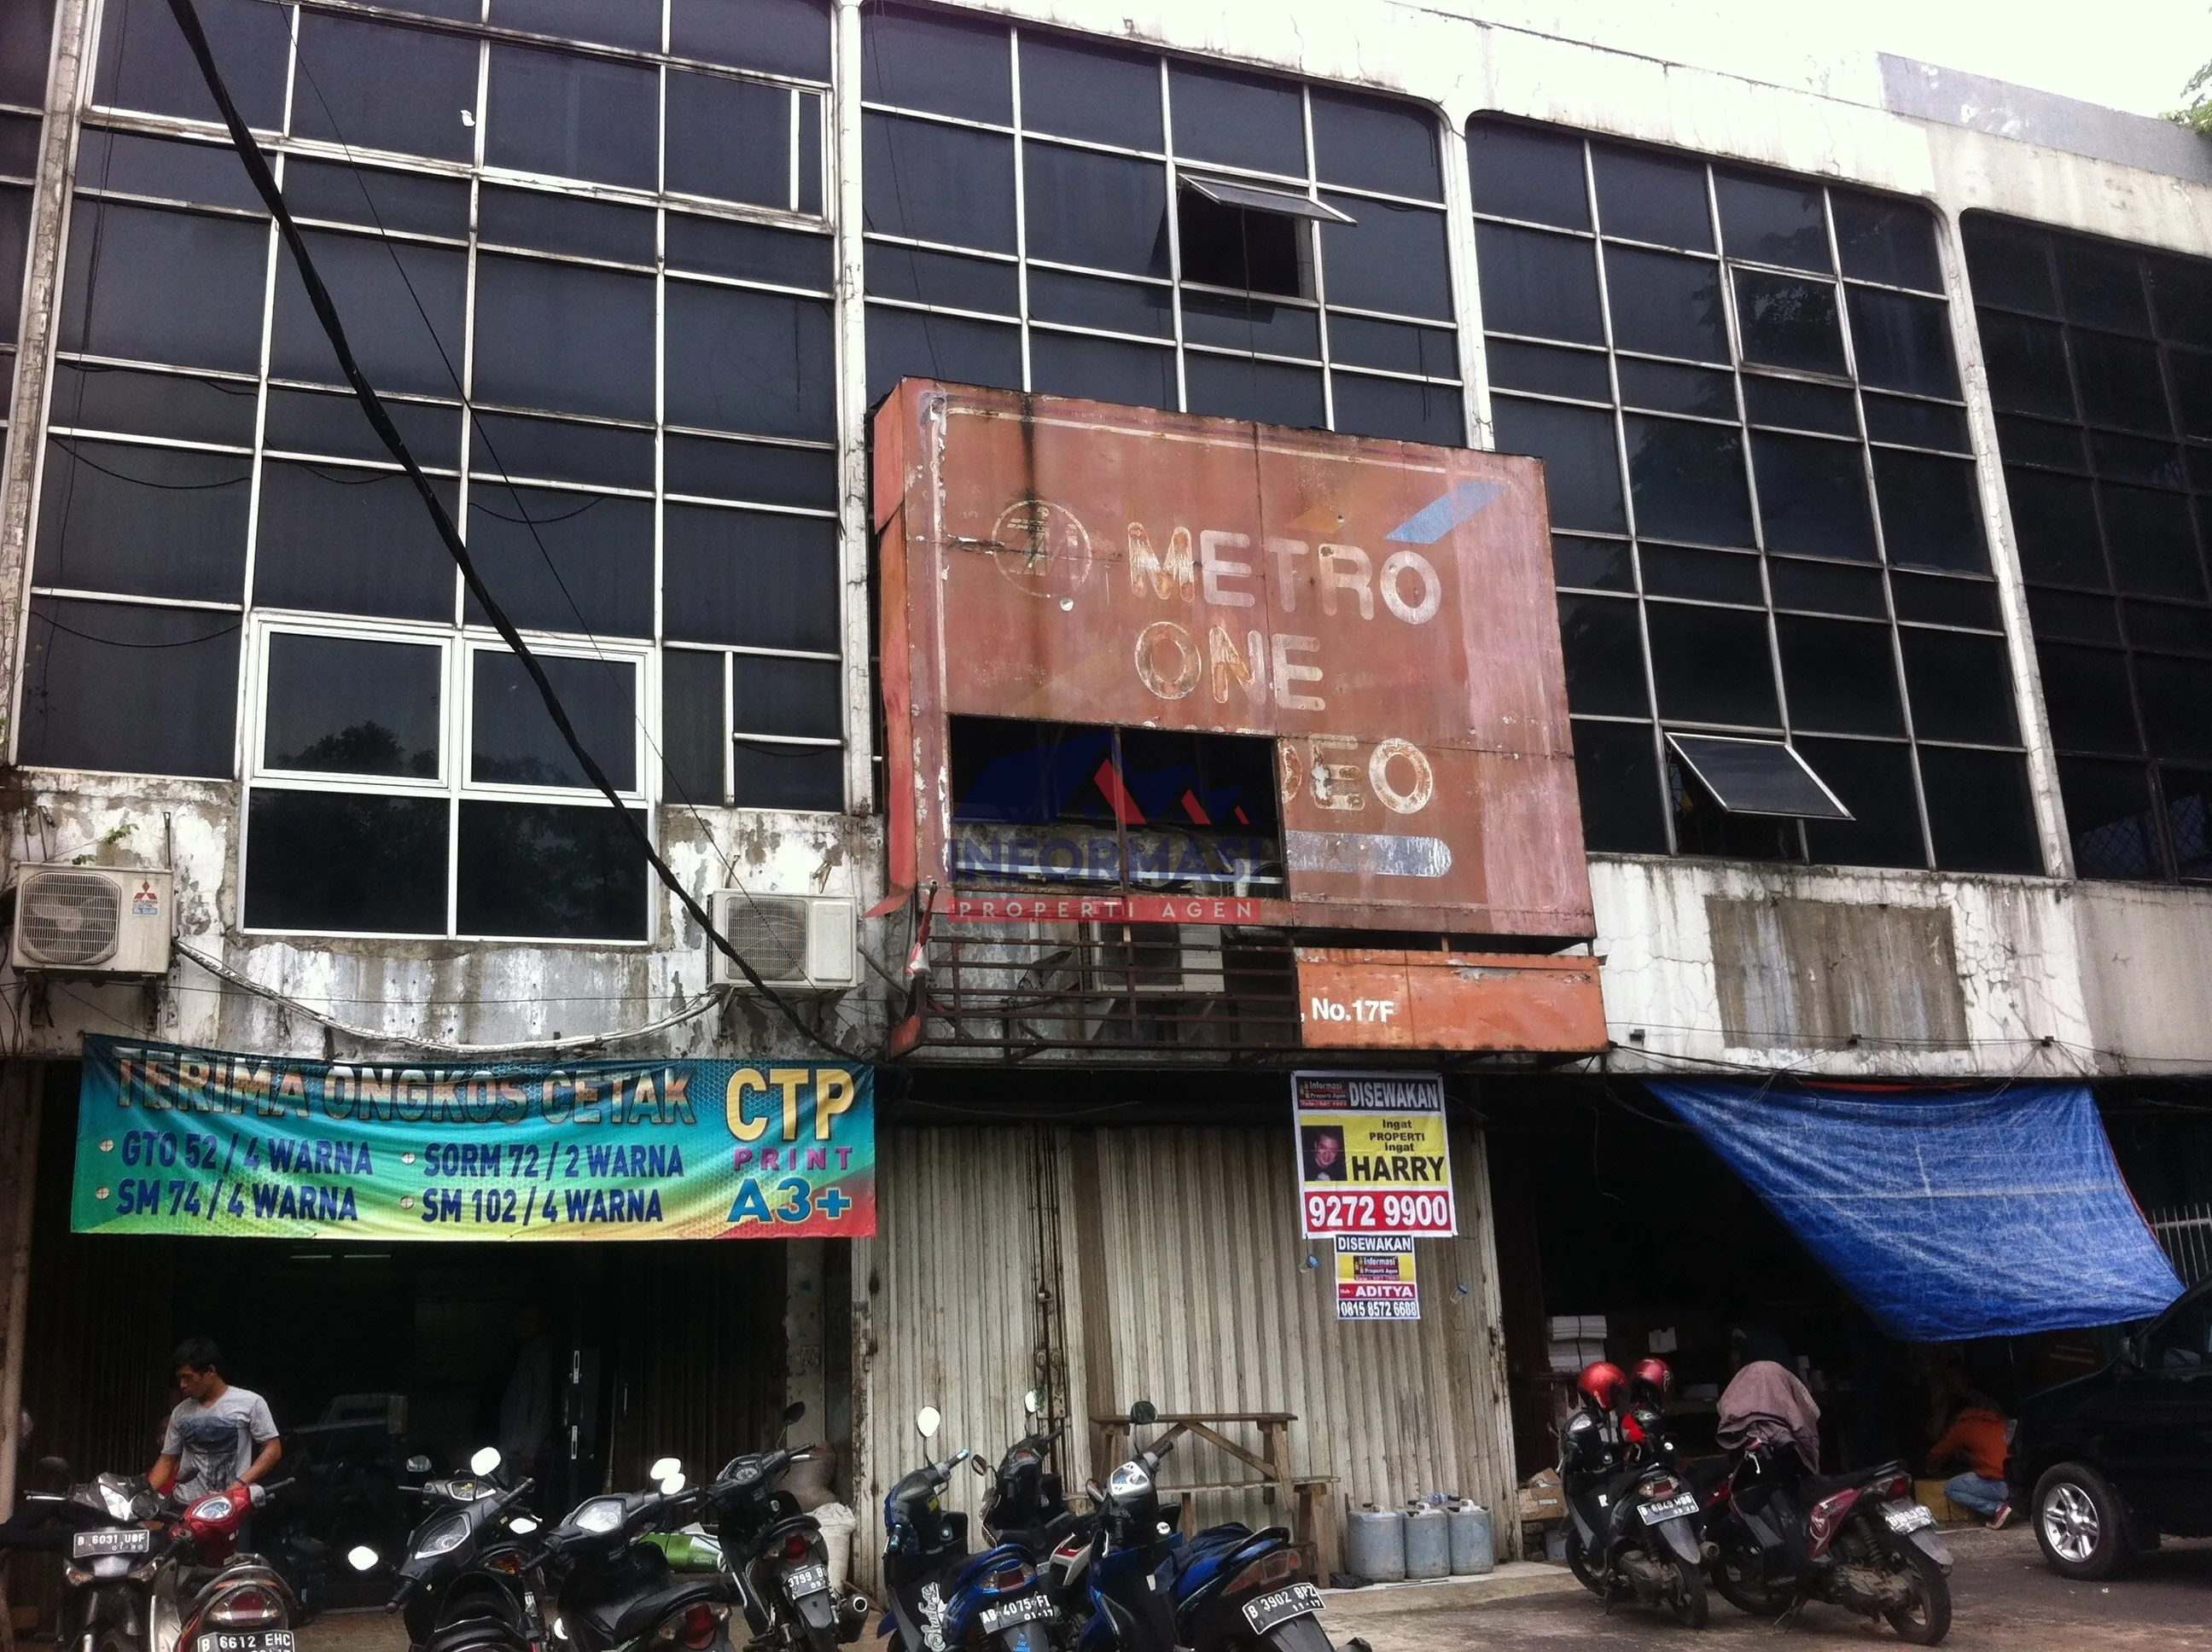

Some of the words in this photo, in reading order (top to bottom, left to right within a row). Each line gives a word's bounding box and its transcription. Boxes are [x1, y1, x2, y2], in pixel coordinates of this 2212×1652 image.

[1126, 521, 1442, 625] METRO
[1135, 620, 1328, 713] ONE
[112, 1046, 310, 1118] TERIMA
[323, 1065, 529, 1125] ONGKOS
[542, 1068, 698, 1125] CETAK
[1348, 1081, 1439, 1108] DISEWAKAN
[726, 1067, 855, 1143] CTP
[1369, 1131, 1425, 1142] PROPERTI
[1382, 1119, 1412, 1131] Ingat
[122, 1130, 178, 1166] GTO
[184, 1132, 218, 1169] 52
[267, 1138, 373, 1175] WARNA
[423, 1143, 501, 1178] SORM
[508, 1143, 539, 1178] 72
[586, 1143, 684, 1178] WARNA
[734, 1146, 853, 1171] PRINT
[1384, 1142, 1415, 1153] Ingat
[1352, 1155, 1446, 1182] HARRY
[116, 1178, 161, 1215] SM
[169, 1179, 201, 1217] 74
[252, 1183, 358, 1221] WARNA
[422, 1188, 463, 1223] SM
[471, 1189, 517, 1223] 102
[566, 1188, 663, 1223] WARNA
[726, 1177, 852, 1224] A3+
[1308, 1195, 1376, 1228] 9272
[1383, 1195, 1448, 1227] 9900
[1337, 1236, 1412, 1251] DISEWAKAN
[1355, 1285, 1413, 1297] ADITYA
[1341, 1301, 1365, 1317] 0815
[1367, 1301, 1392, 1317] 8572
[1003, 1597, 1032, 1616] 4075
[1247, 1605, 1259, 1619] B
[1260, 1591, 1293, 1612] 3902
[201, 1637, 210, 1652] B
[219, 1635, 256, 1649] 6612
[265, 1632, 291, 1646] EHC
